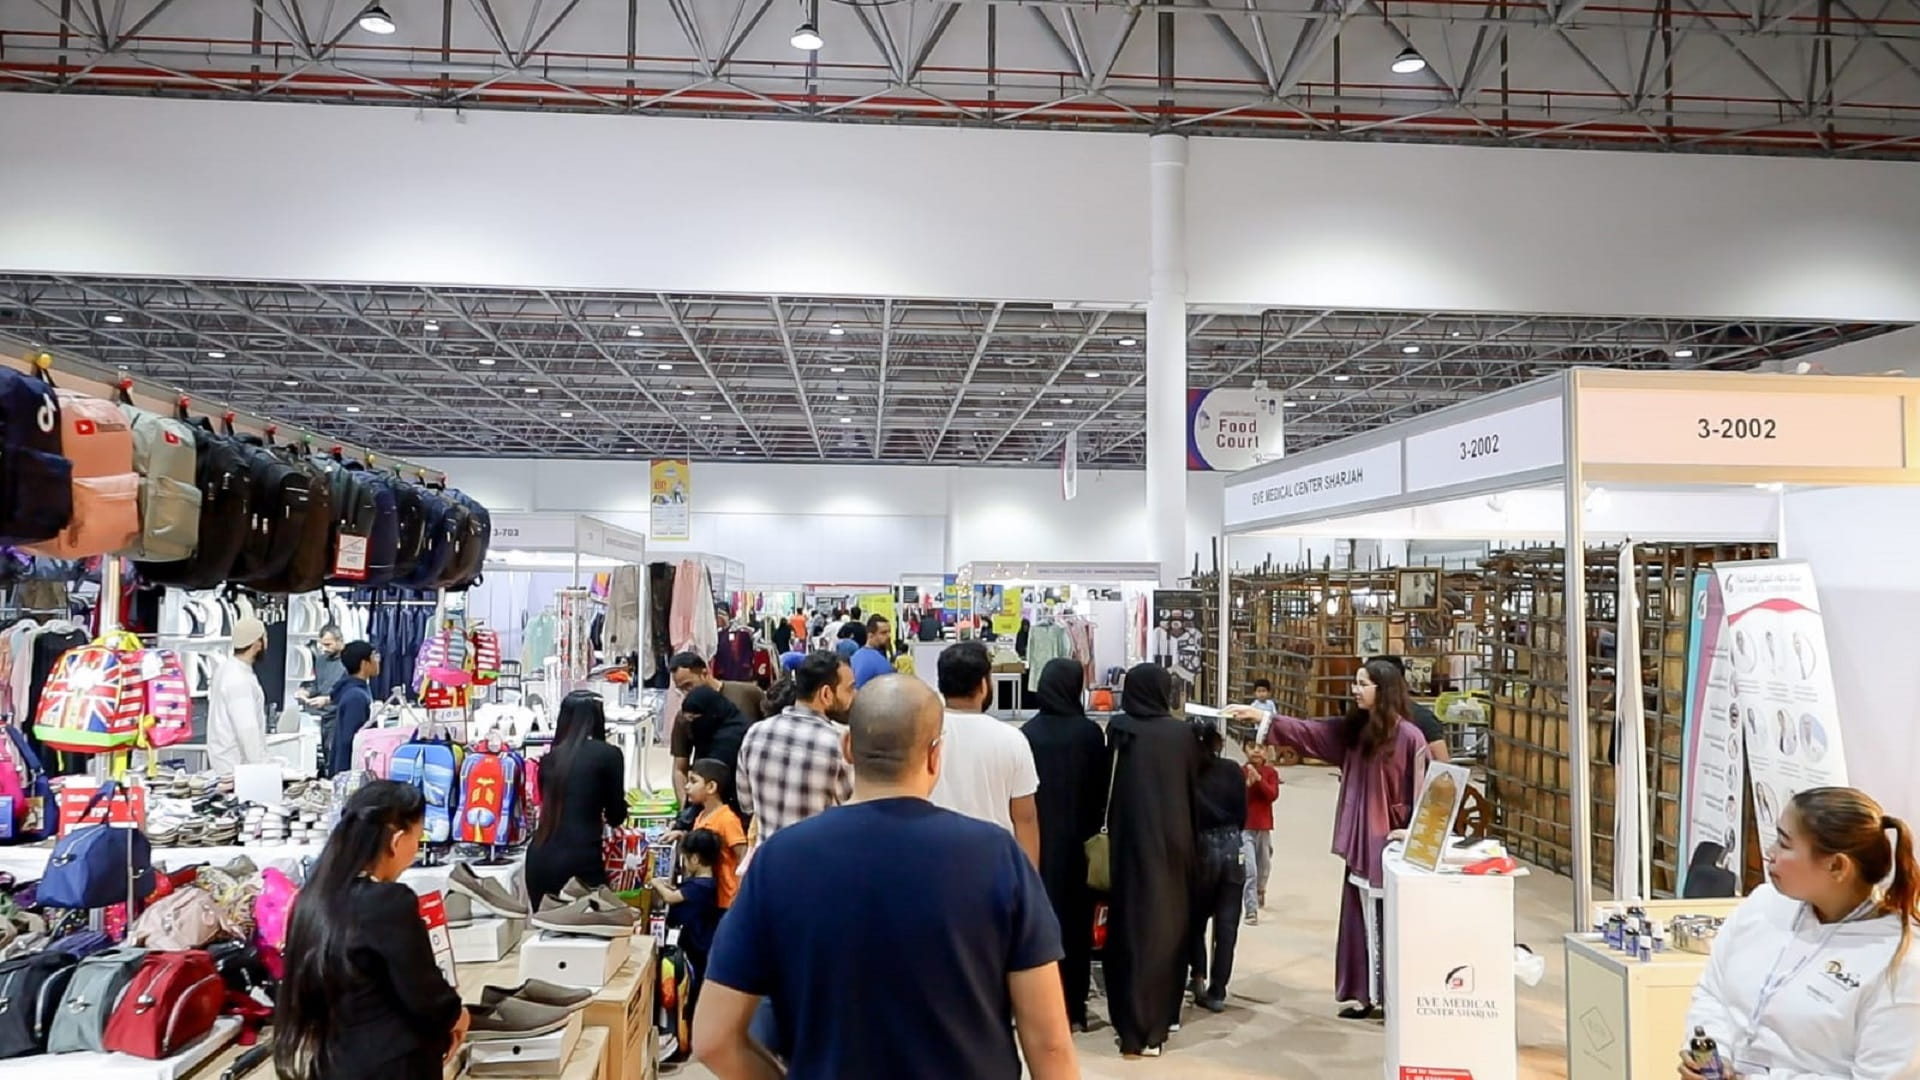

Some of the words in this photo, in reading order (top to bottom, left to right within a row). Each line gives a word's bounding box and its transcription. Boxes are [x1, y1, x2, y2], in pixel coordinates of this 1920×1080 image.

[1218, 419, 1257, 433] Food
[1698, 418, 1777, 439] 3-2002
[1216, 434, 1259, 448] Court
[1460, 434, 1500, 460] 3-2002
[1252, 492, 1264, 506] EVE
[1265, 484, 1294, 503] MEDICAL
[1294, 477, 1325, 496] CENTER
[1325, 468, 1363, 490] SHARJAH
[1416, 996, 1440, 1008] EVE
[1442, 999, 1496, 1009] MEDICAL
[1416, 1007, 1455, 1017] CENTER
